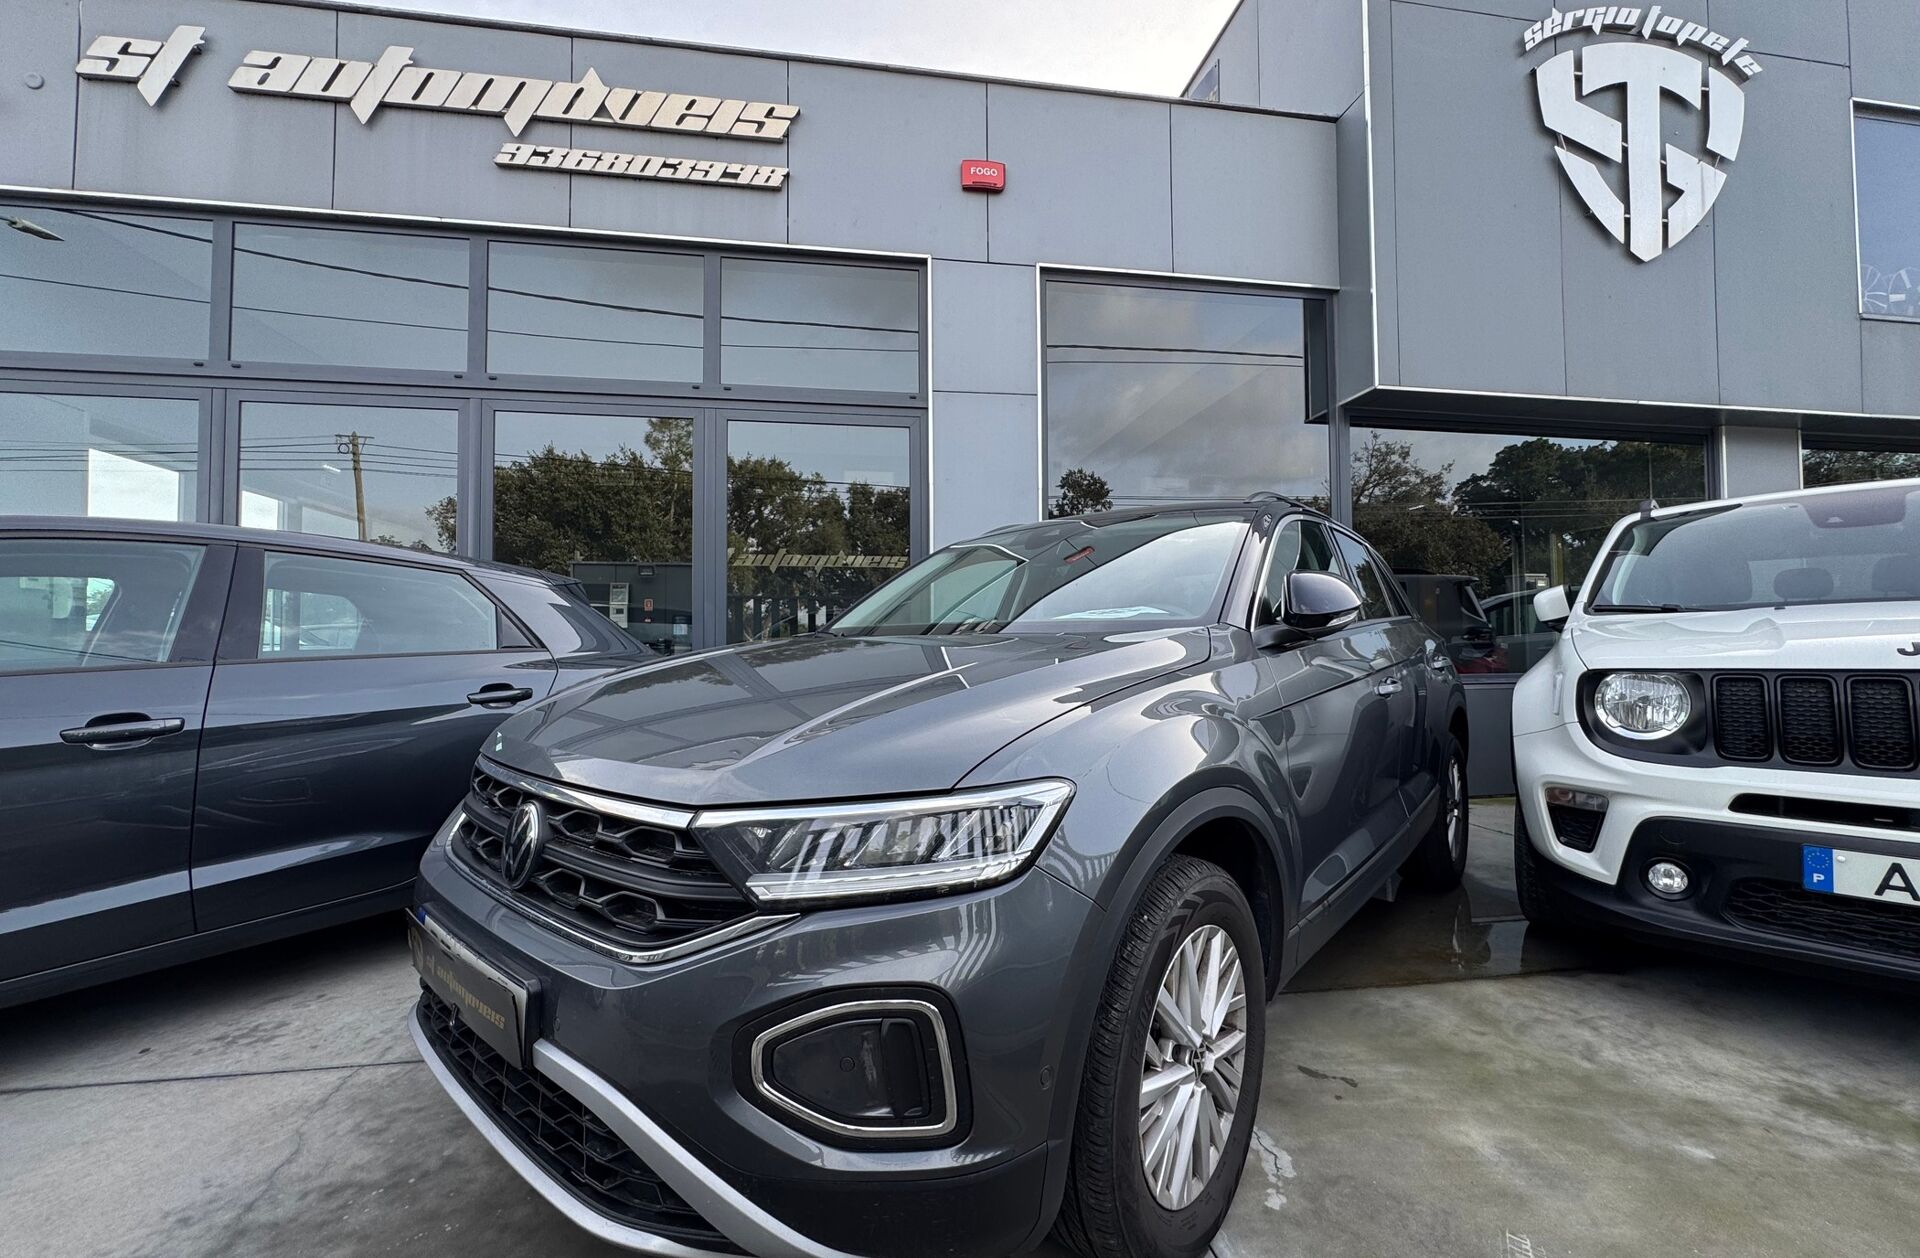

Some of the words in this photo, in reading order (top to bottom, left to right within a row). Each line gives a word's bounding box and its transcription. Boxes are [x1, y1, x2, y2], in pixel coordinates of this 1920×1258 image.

[228, 45, 800, 138] automóveis
[970, 166, 998, 177] FOGO
[1812, 872, 1825, 883] P
